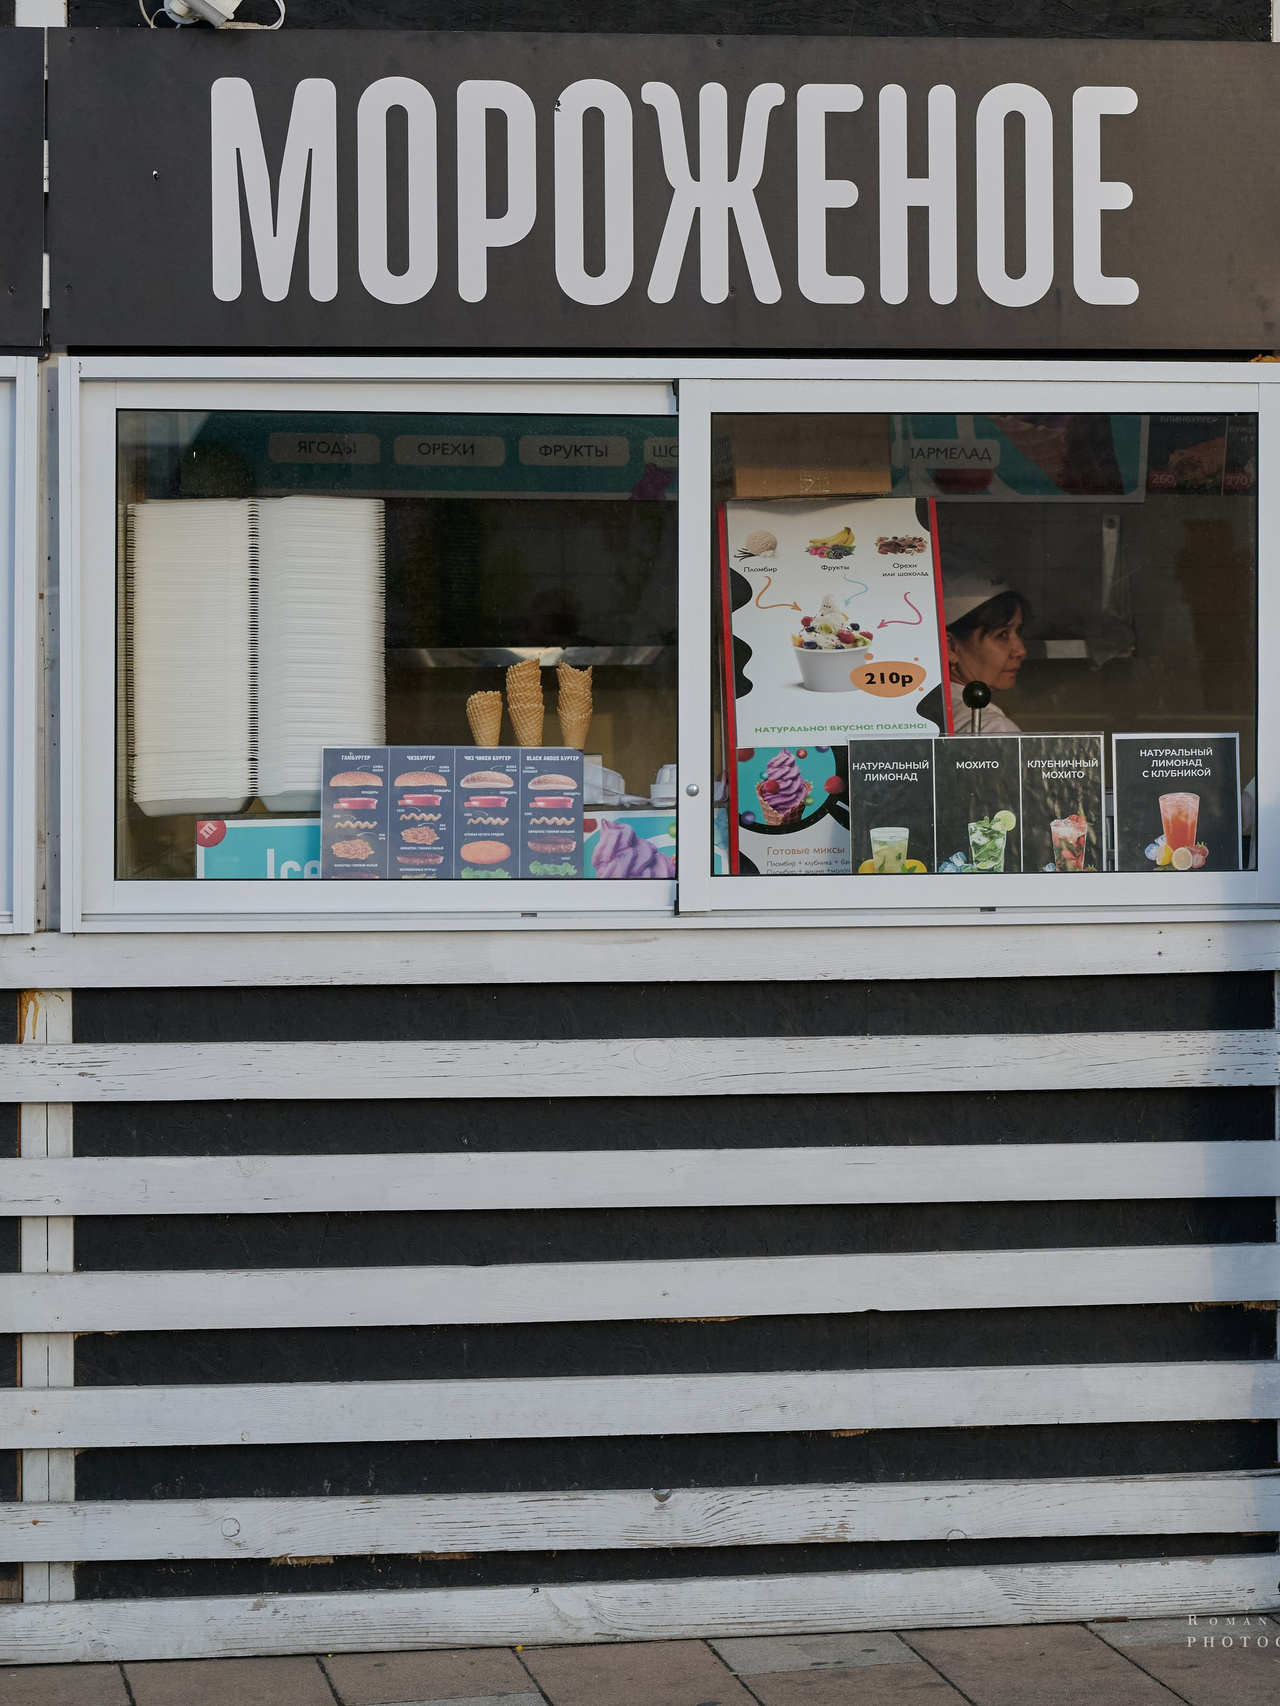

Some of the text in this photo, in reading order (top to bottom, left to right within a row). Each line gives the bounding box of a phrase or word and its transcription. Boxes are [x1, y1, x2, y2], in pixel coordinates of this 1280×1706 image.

[210, 76, 1140, 308] МОРОЖЕНОЕ
[297, 441, 357, 455] ЯГОДЫ
[418, 443, 475, 456] ОРЕХИ
[538, 444, 608, 459] ФРУКТЫ
[911, 447, 992, 461] АРМЕЛАД
[1152, 474, 1174, 484] 260
[1226, 476, 1248, 485] 270
[743, 566, 778, 574] Пломбир
[821, 564, 850, 572] Фрукты
[864, 672, 914, 687] 210р
[755, 723, 927, 734] НАТУРАЛЬНО! ВКУСНО! ПОЛЕЗНО!
[1139, 747, 1213, 758] НАТУРАЛЬНЫЙ
[852, 759, 930, 771] НАТУРАЛЬНЫЙ
[956, 761, 1000, 770] МОХИТО
[1027, 757, 1099, 769] КЛУБНИЧНЫЙ
[1151, 759, 1203, 768] ЛИМОНАД
[864, 772, 918, 782] ЛИМОНАД
[1041, 769, 1085, 779] МОХИТО
[1142, 767, 1212, 778] С КЛУБНИКОЙ
[767, 846, 810, 855] Готовые
[766, 860, 797, 868] Пломбир
